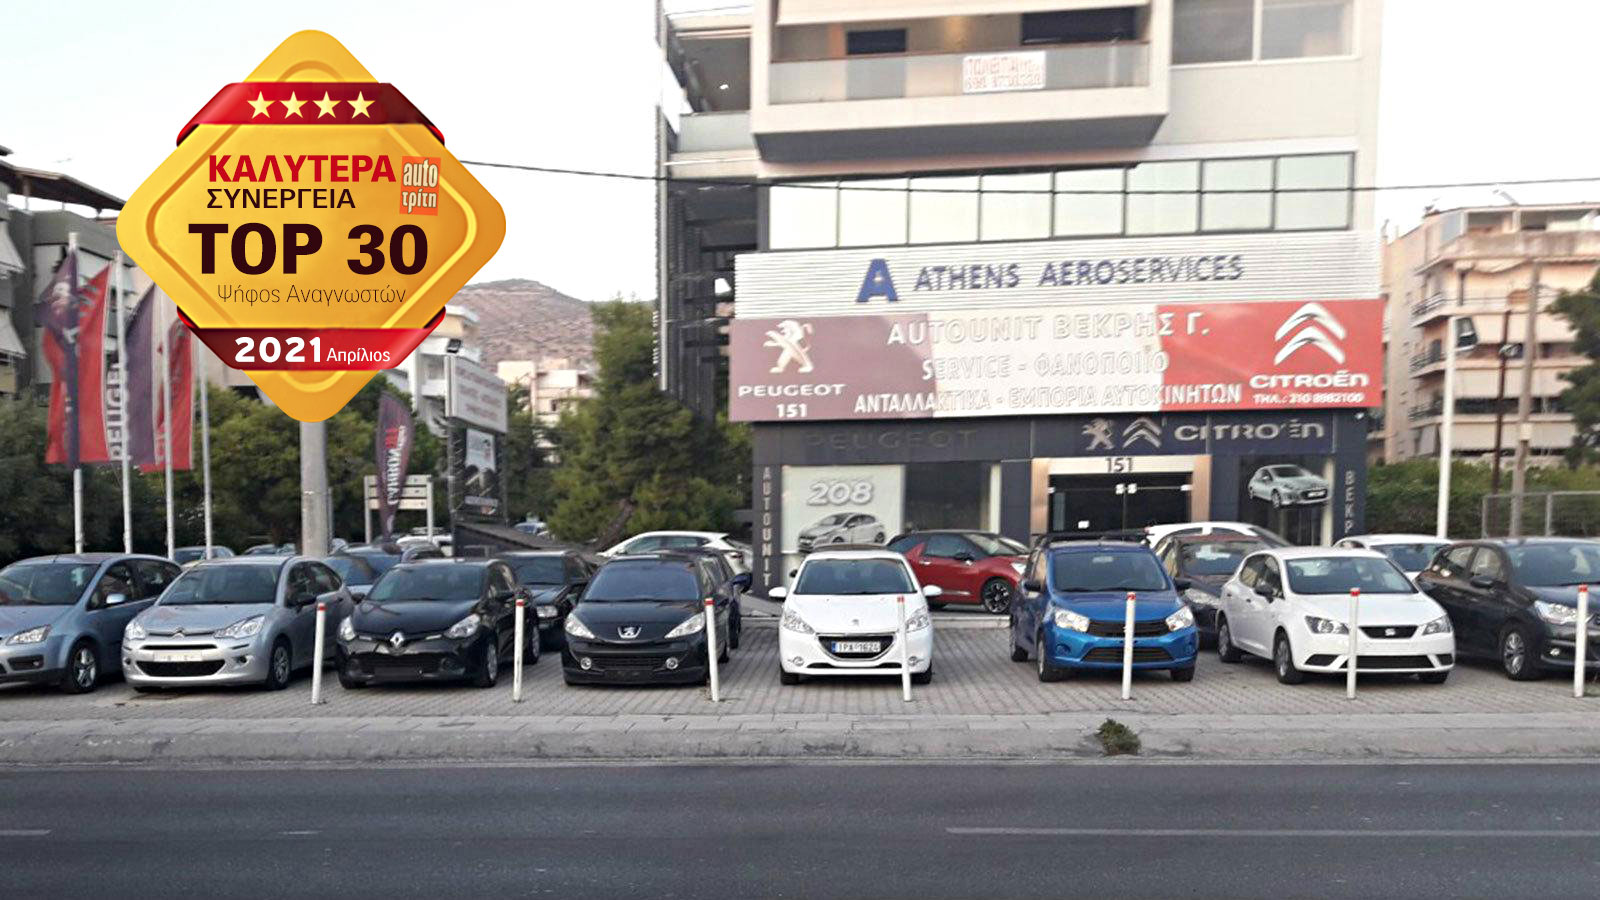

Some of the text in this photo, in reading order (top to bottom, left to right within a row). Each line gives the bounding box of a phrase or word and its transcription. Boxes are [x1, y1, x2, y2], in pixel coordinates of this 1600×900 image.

[914, 263, 1020, 292] ATHENS
[1038, 255, 1243, 287] AEROSERVICES
[887, 315, 1043, 345] AUTOUNIT
[922, 355, 1011, 381] SERVICE
[738, 383, 846, 397] PEUGEOT
[776, 402, 808, 419] 151
[806, 429, 977, 450] PEUGEOT
[1105, 457, 1132, 473] 151
[807, 480, 875, 506] 208
[761, 466, 771, 587] AUTOUNIT
